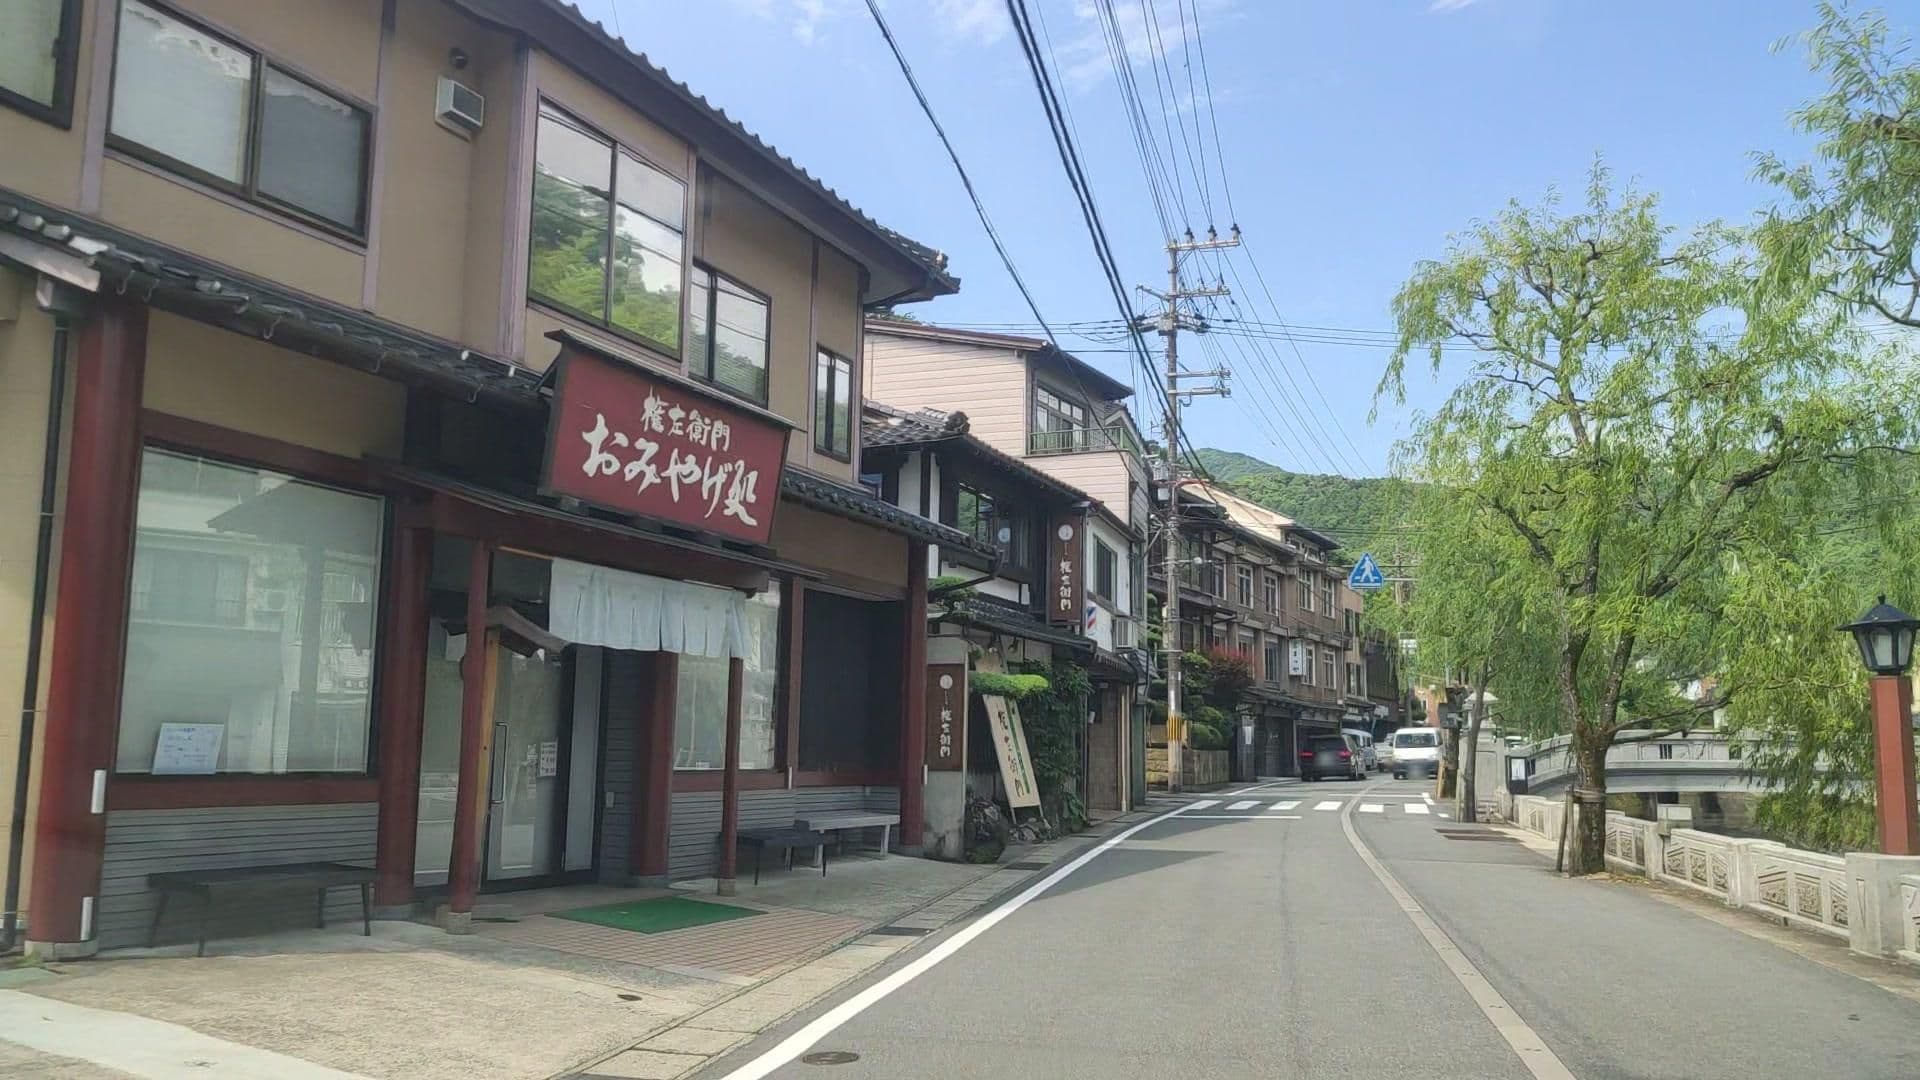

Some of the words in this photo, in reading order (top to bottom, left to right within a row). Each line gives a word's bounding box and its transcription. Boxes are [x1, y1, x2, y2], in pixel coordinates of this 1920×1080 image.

[582, 413, 757, 525] おみやげ処
